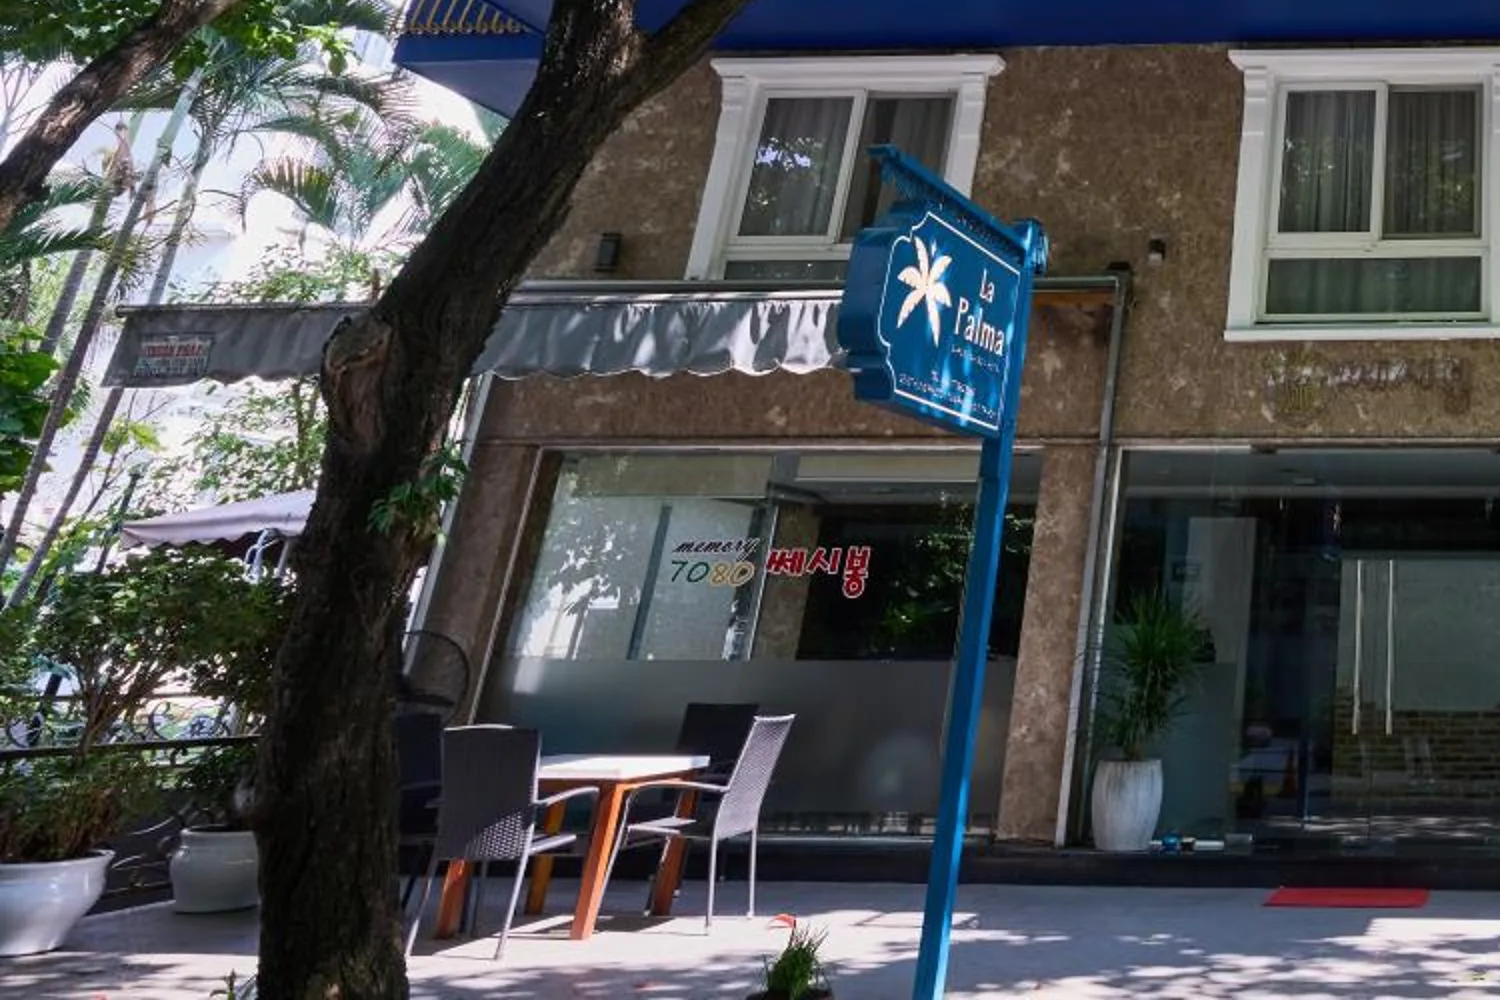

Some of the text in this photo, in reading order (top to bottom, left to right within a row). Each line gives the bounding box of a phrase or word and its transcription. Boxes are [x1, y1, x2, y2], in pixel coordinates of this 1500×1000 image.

[979, 268, 995, 304] La
[954, 297, 1005, 356] Palma
[672, 538, 760, 562] memory
[671, 559, 755, 587] 7080
[767, 546, 871, 599] 쎄시봉
